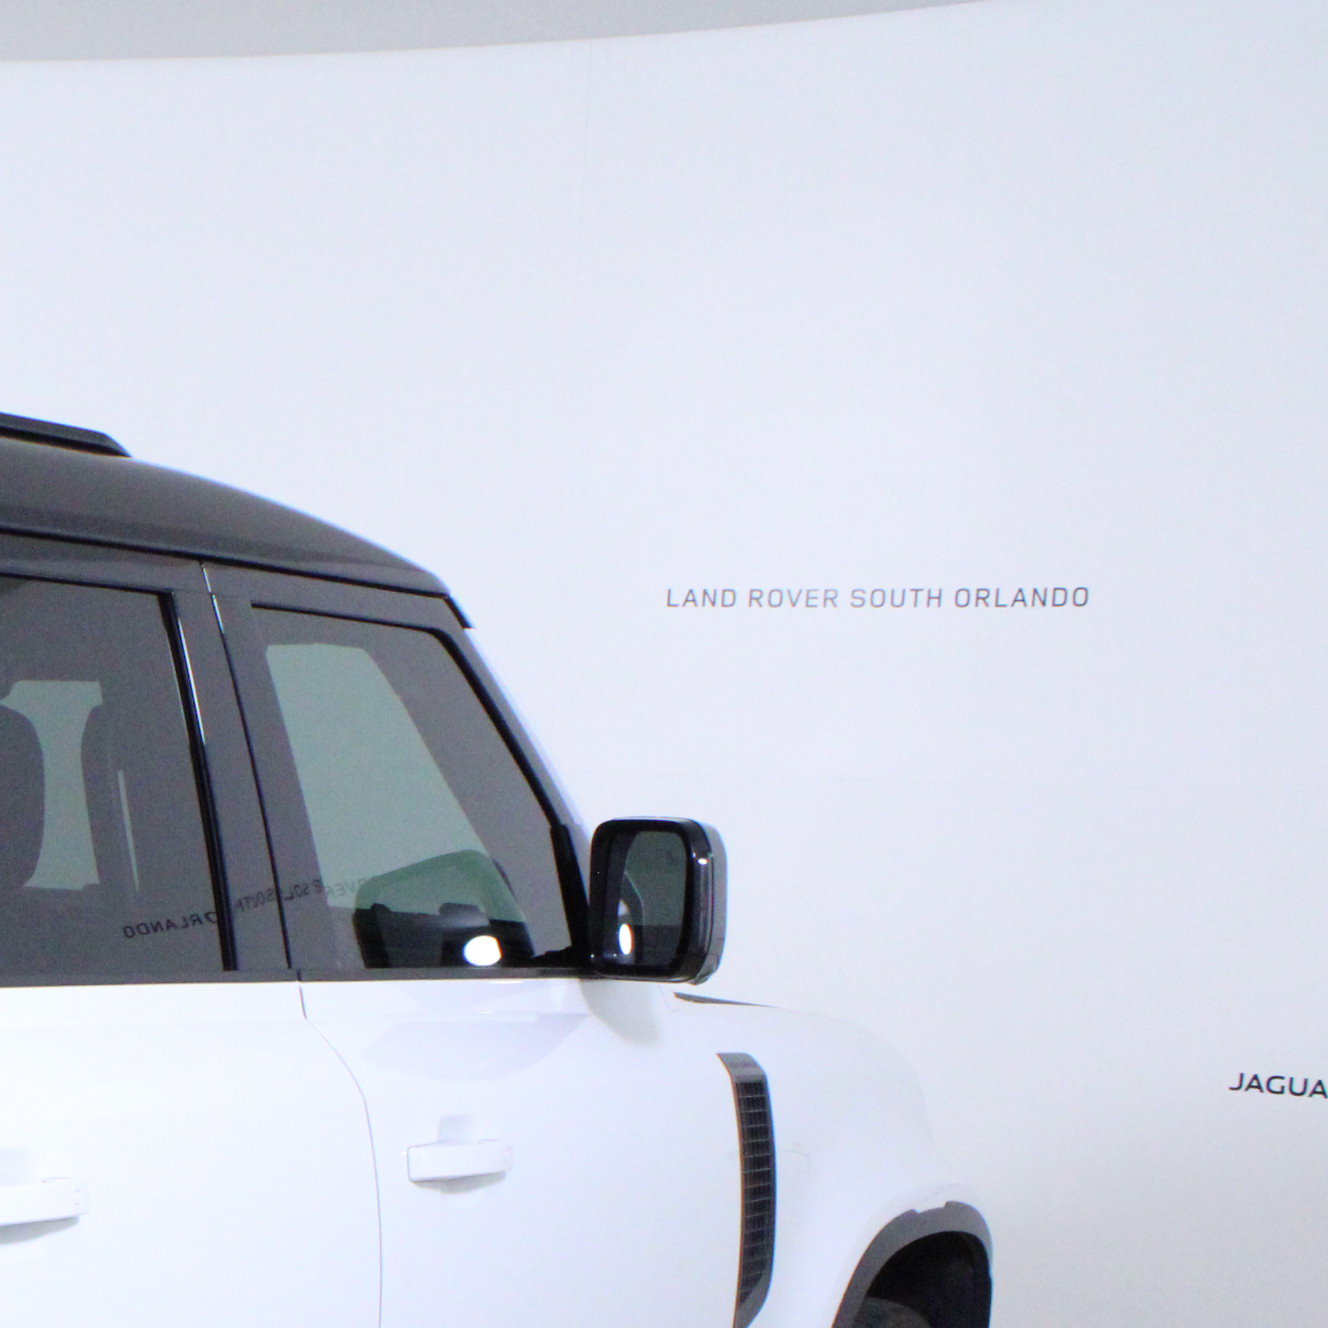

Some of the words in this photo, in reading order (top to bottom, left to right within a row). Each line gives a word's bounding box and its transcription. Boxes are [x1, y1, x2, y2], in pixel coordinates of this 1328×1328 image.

[666, 587, 737, 608] LAND
[748, 587, 838, 608] ROVER
[850, 587, 943, 608] SOUTH
[954, 586, 1089, 608] ORLANDO
[1228, 1072, 1328, 1099] JAGUA
